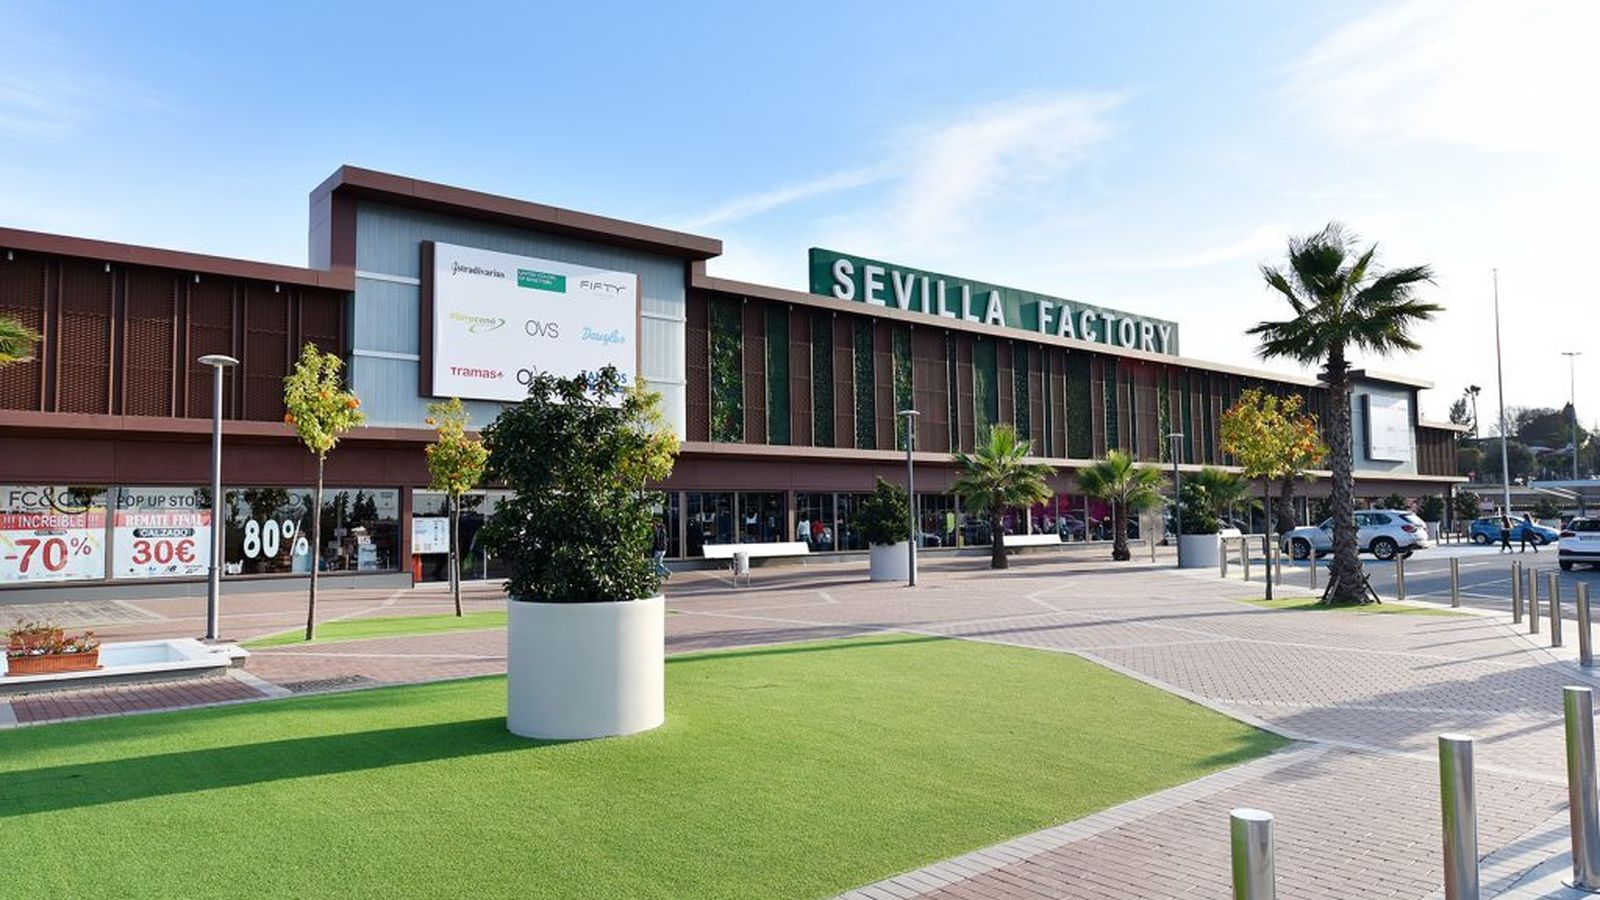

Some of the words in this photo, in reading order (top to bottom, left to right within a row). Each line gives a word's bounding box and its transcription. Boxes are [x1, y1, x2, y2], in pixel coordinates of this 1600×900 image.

[580, 280, 626, 294] FIFTY
[832, 259, 1005, 327] SEVILLA
[1037, 300, 1172, 355] FACTORY
[525, 319, 560, 339] OVS
[148, 496, 166, 507] UP
[19, 514, 84, 529] INCREIBLE
[125, 514, 169, 527] REMATE
[172, 514, 200, 527] FINAL
[244, 519, 309, 559] 80%
[4, 537, 92, 573] -70%
[132, 539, 195, 565] 30€
